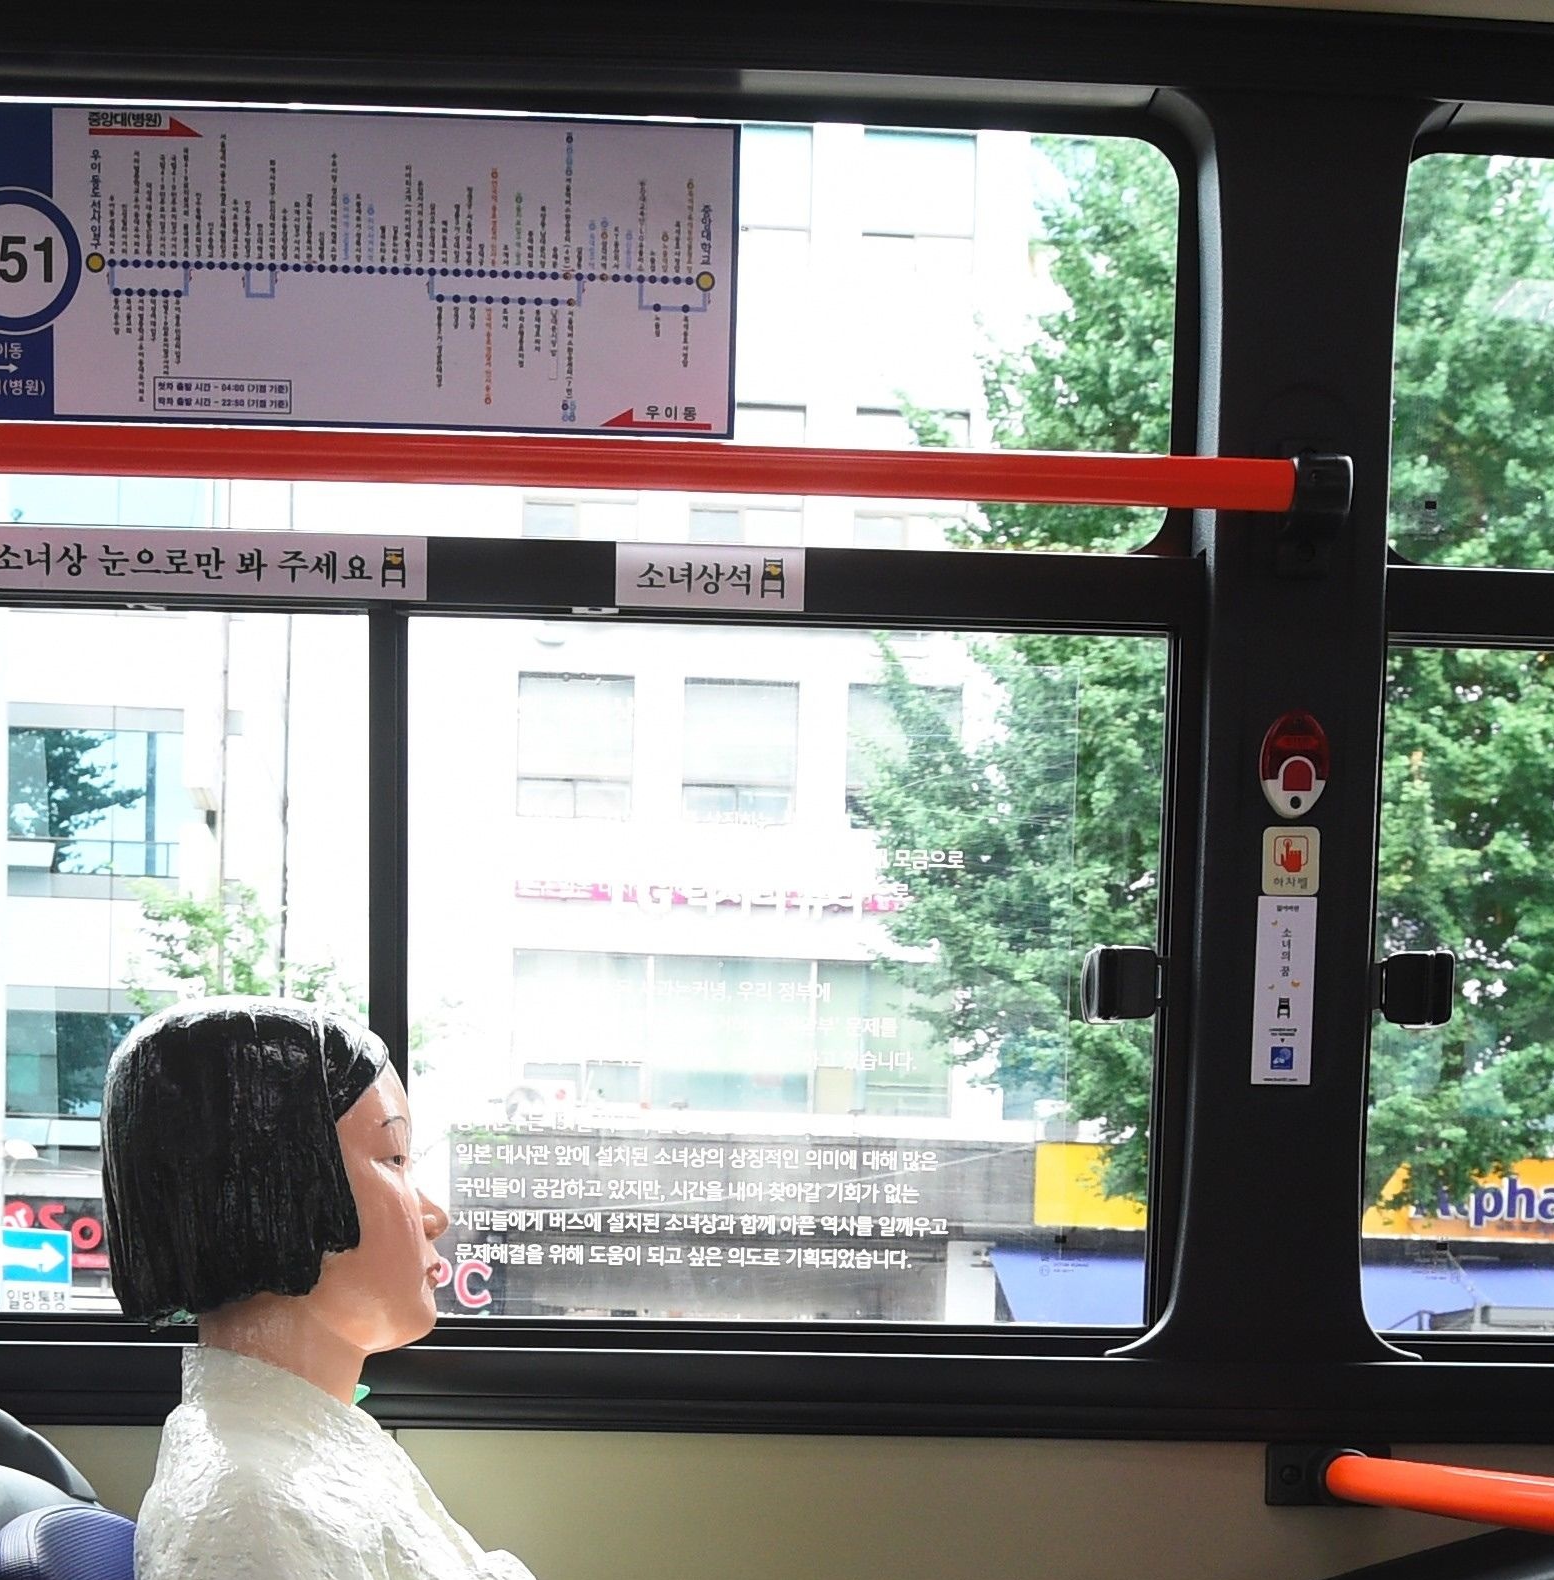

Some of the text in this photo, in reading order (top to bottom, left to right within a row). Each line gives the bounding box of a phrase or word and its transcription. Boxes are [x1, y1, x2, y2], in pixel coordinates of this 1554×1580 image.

[88, 112, 162, 127] 중앙대(병원)
[158, 382, 173, 391] 첫차
[176, 382, 192, 392] 출발
[195, 383, 211, 392] 시간
[176, 397, 192, 407] 출발
[195, 398, 211, 407] 시간
[98, 544, 226, 580] 눈으로만
[238, 548, 268, 582] 봐
[278, 550, 374, 585] 주세요
[637, 562, 751, 596] 소녀상석
[893, 849, 965, 870] 모금으로
[1274, 877, 1308, 890] 하차벨
[1281, 927, 1292, 961] 소녀의
[737, 981, 773, 999] 우리
[778, 981, 832, 1001] 정부에
[455, 1143, 939, 1172] 일본 대사관 앞에 설치된 소녀상의 상징적인 의미에 대해 많은
[455, 1177, 920, 1204] 국민들이 공감하고 있지만, 시간을 내어 찾아갈 기회가 없는
[455, 1210, 949, 1237] 시민들에게 버스에 설치된 소녀상과 함께 아픈 역사를 일깨우고
[455, 1244, 912, 1270] 문제해결을 위해 도움이 되고 싶은 의도로 기획되었습니다.
